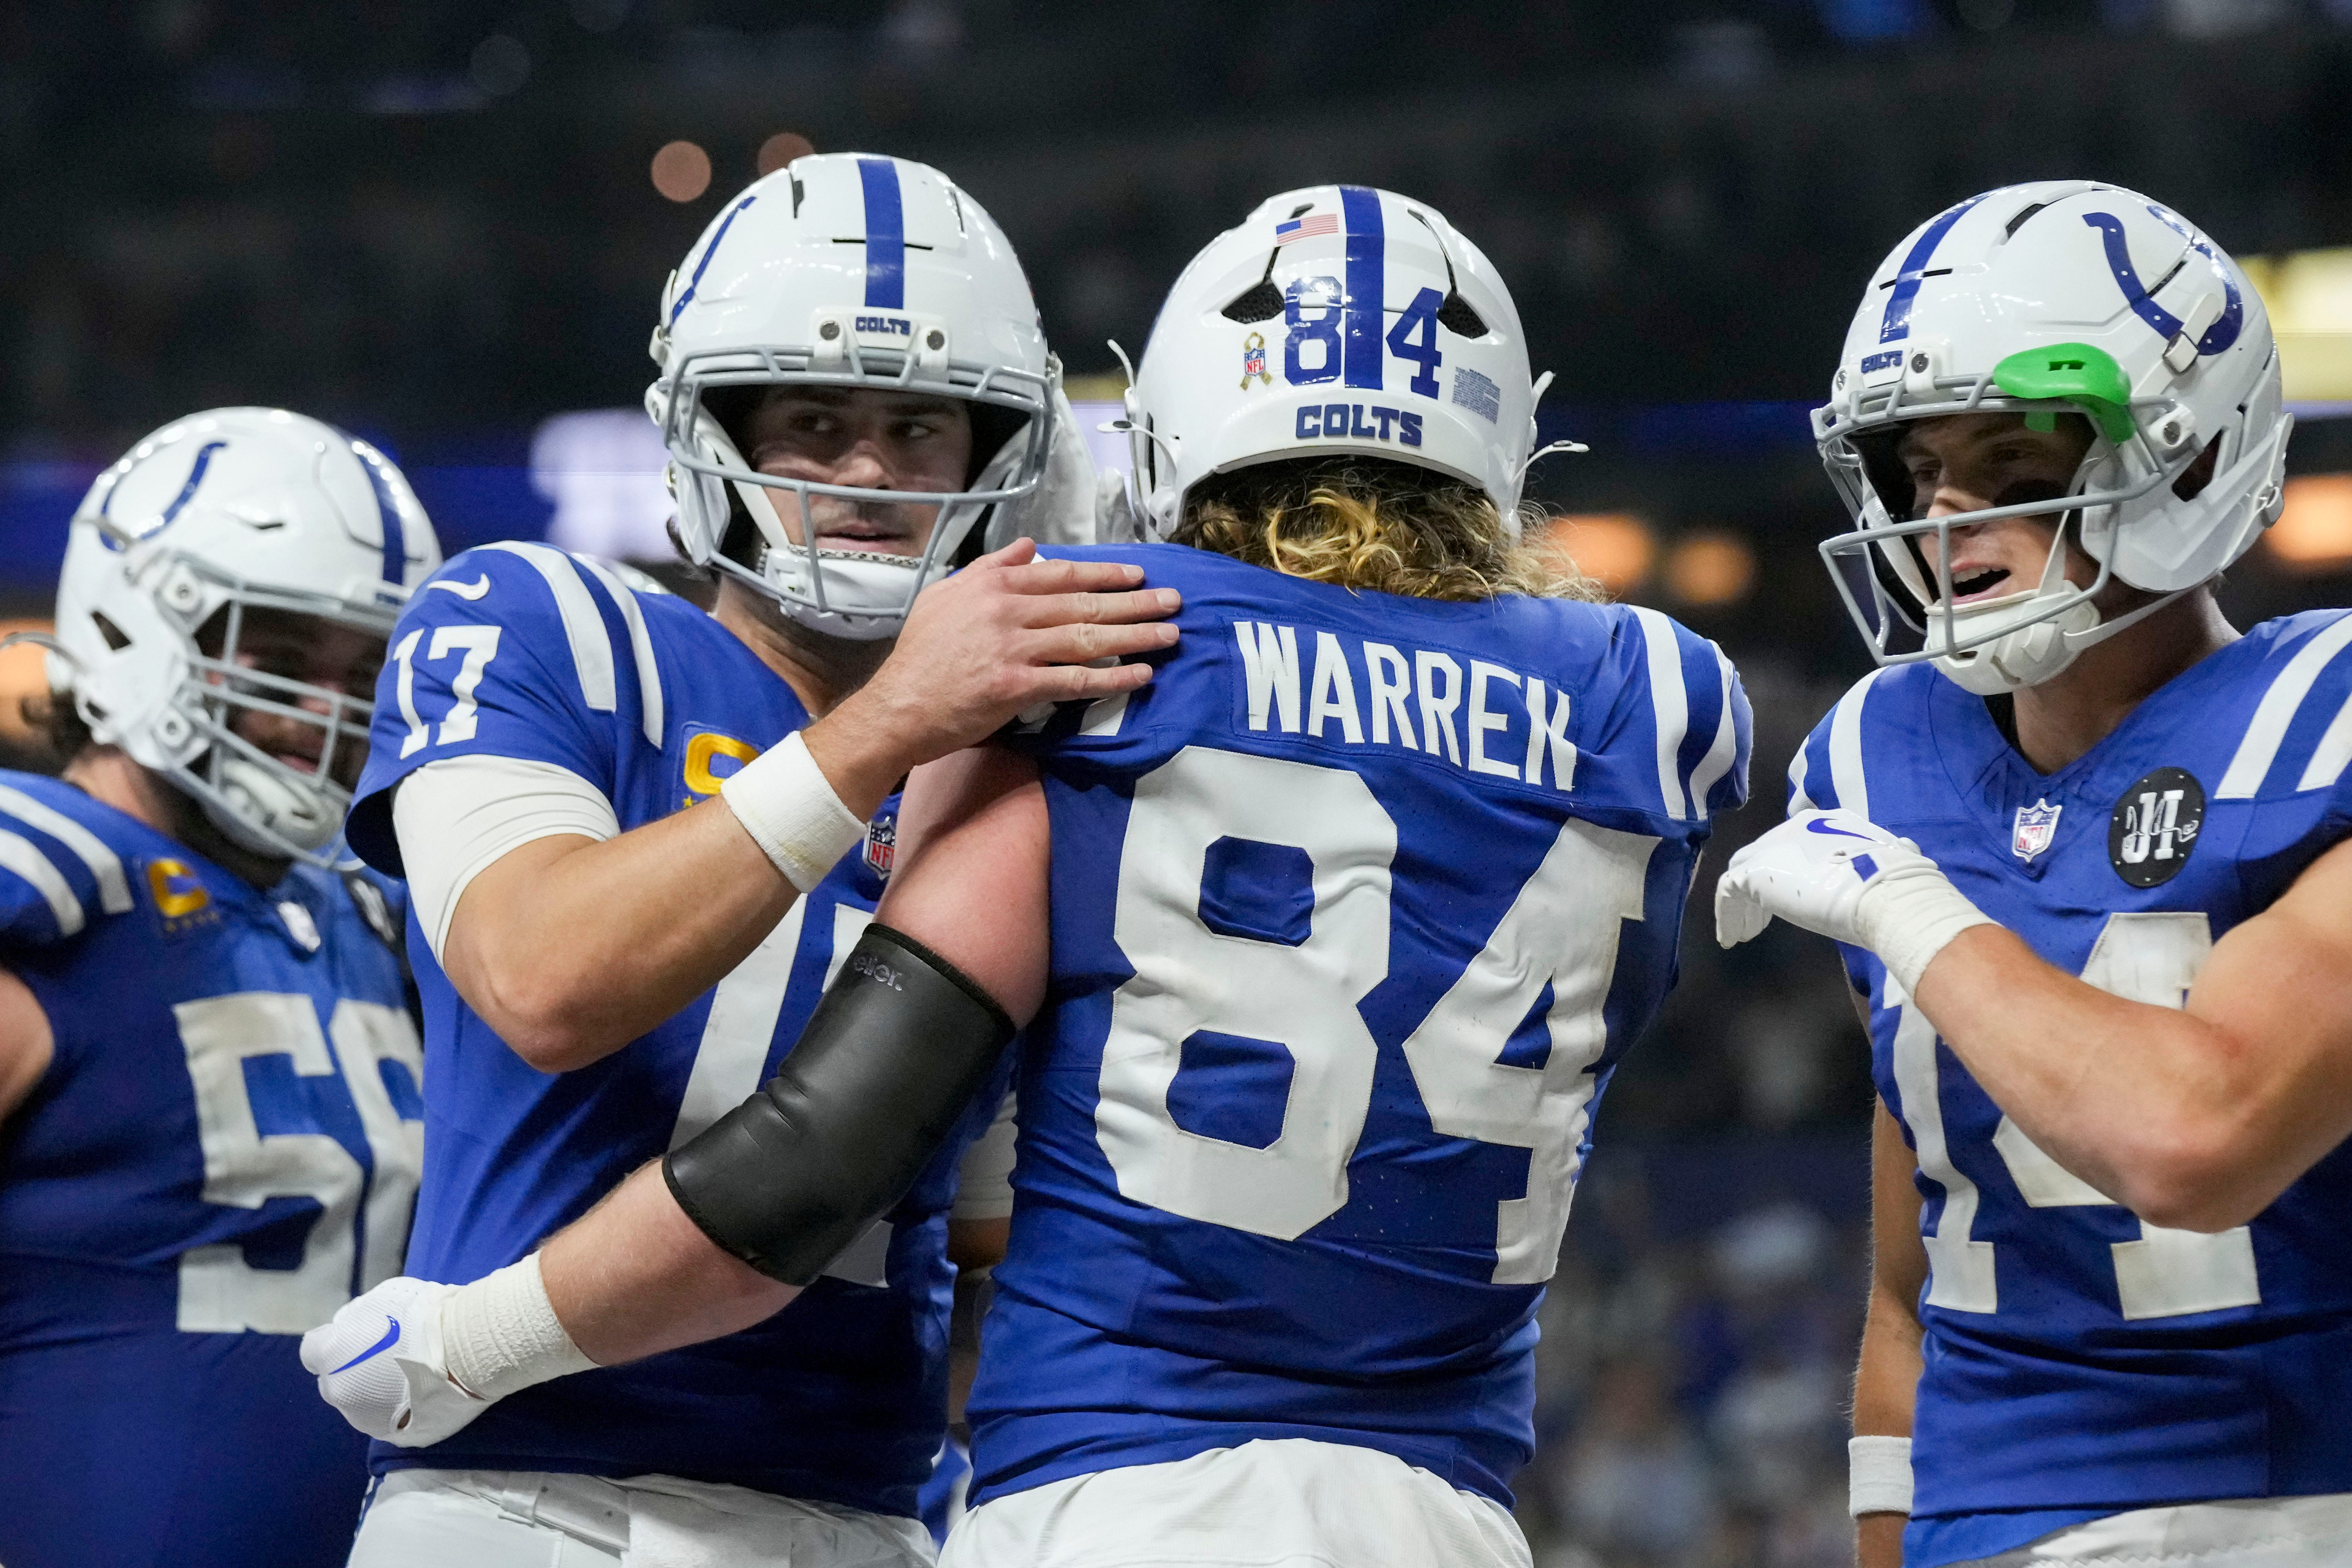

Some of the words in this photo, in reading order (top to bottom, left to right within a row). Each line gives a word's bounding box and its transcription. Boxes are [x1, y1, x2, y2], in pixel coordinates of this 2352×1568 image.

[856, 317, 910, 335] COLTS
[1284, 276, 1444, 400] 84
[1247, 359, 1264, 373] NFL
[1861, 350, 1903, 373] COLTS
[1296, 404, 1423, 448] COLTS
[393, 625, 501, 760] 17
[1233, 621, 1577, 792] WARREN
[148, 858, 208, 917] C
[1095, 745, 1663, 1285] 84
